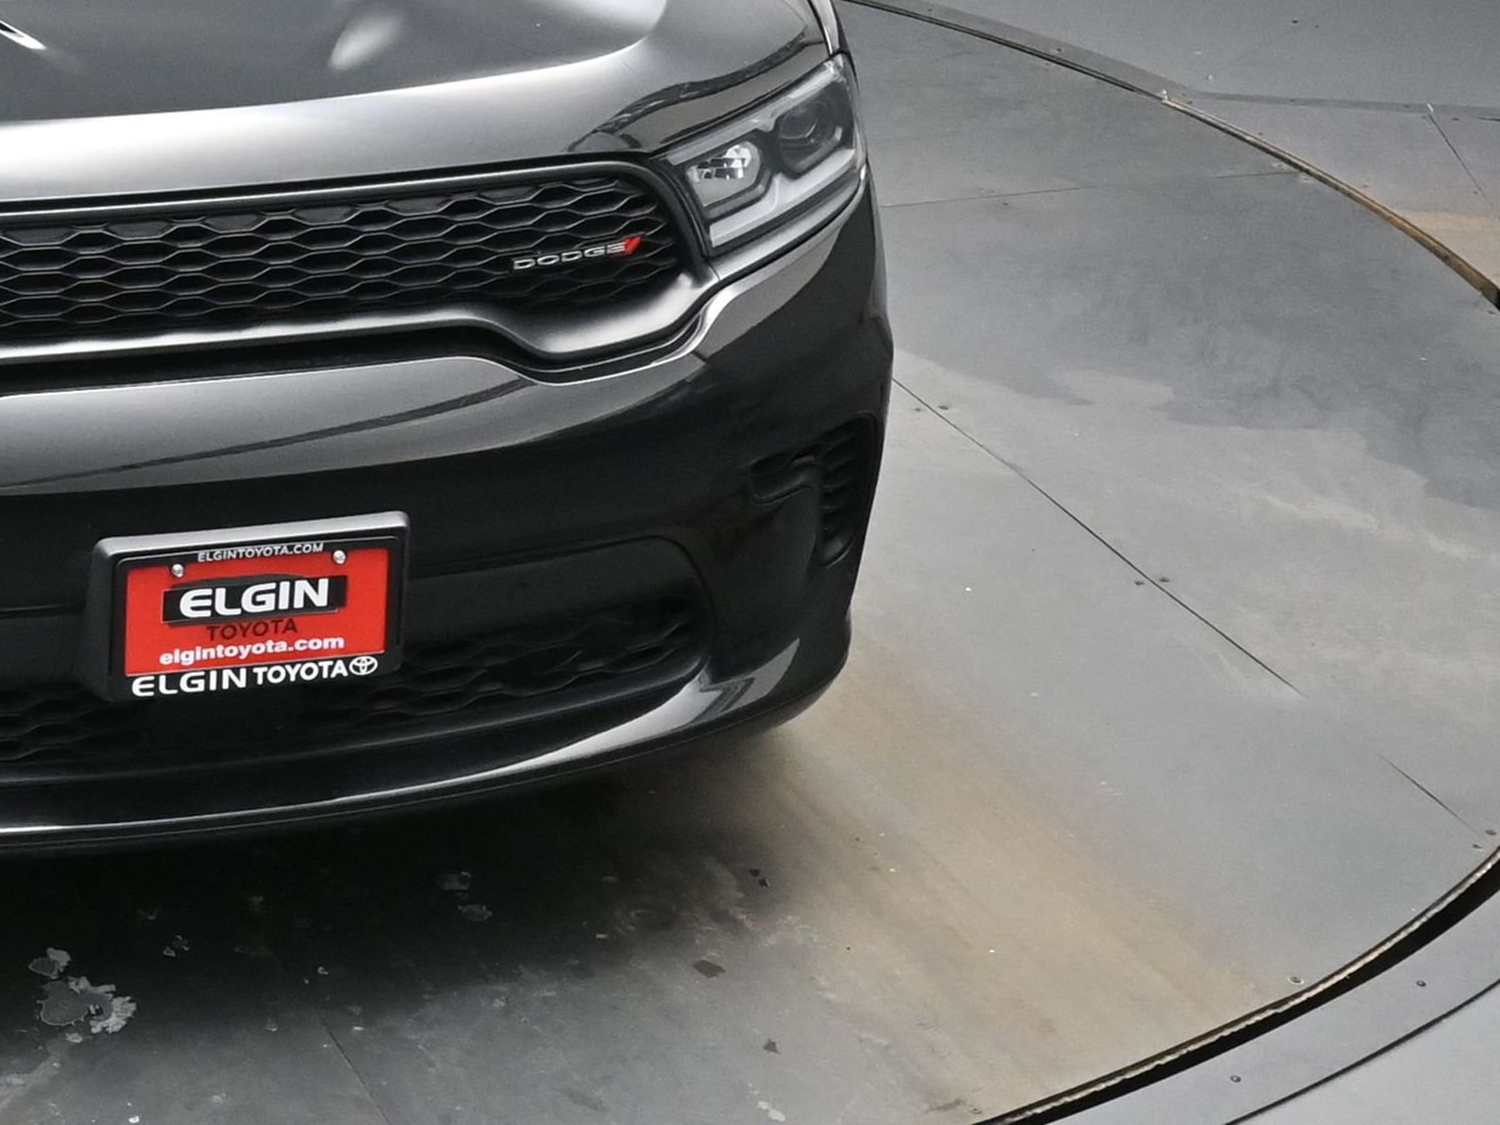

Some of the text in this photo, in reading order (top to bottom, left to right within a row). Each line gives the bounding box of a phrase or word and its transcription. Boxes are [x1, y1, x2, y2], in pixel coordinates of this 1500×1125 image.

[513, 241, 626, 270] DODGE
[197, 543, 324, 562] ELGINTOYOTA.COM
[179, 578, 329, 618] ELGIN
[206, 618, 298, 642] TOYOTA
[159, 635, 345, 666] elgintoyota.com
[131, 660, 349, 697] ELGIN TOYOTA
